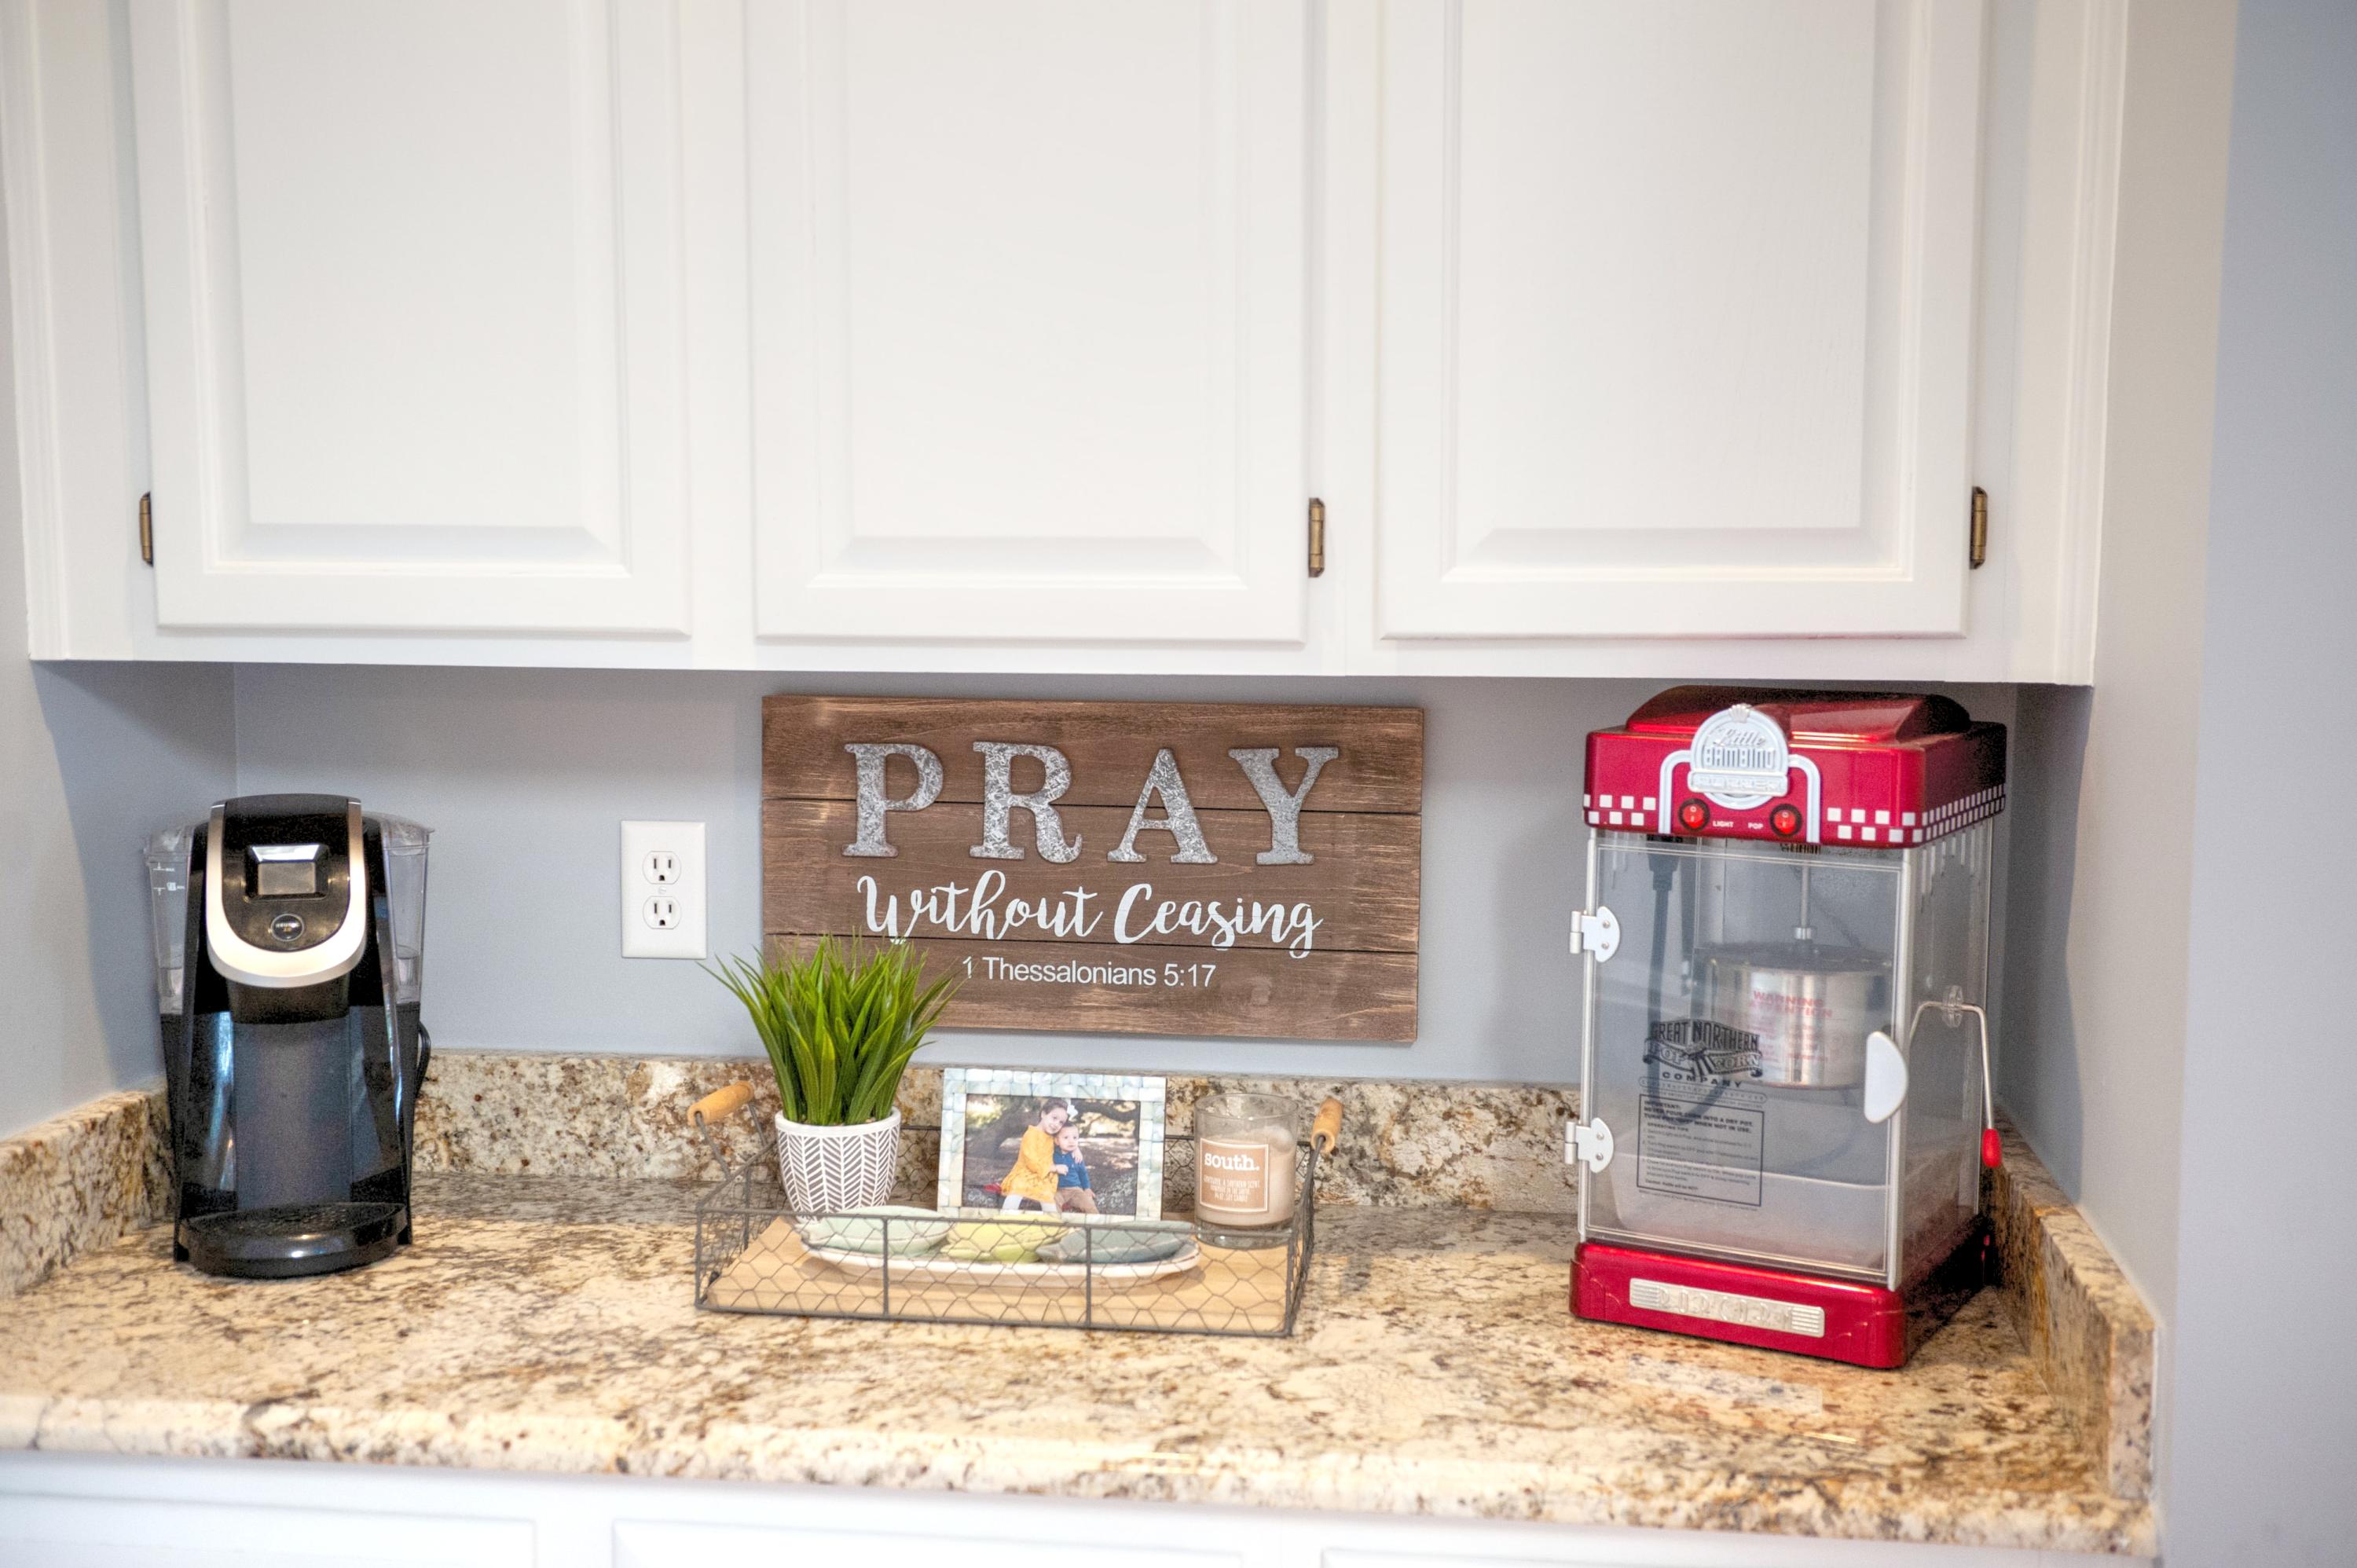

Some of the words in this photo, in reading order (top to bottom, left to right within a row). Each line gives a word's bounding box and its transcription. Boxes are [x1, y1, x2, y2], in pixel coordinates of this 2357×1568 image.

[841, 742, 1339, 865] PRAY
[856, 870, 1104, 945] Without
[1113, 883, 1325, 959] Ceasing
[962, 955, 973, 979] 1
[981, 957, 1157, 986] Thessalonians
[1164, 963, 1216, 987] 5:17
[1692, 1020, 1760, 1053] NORTHERN
[1662, 1071, 1743, 1089] COMPANY
[1204, 1152, 1260, 1171] south.
